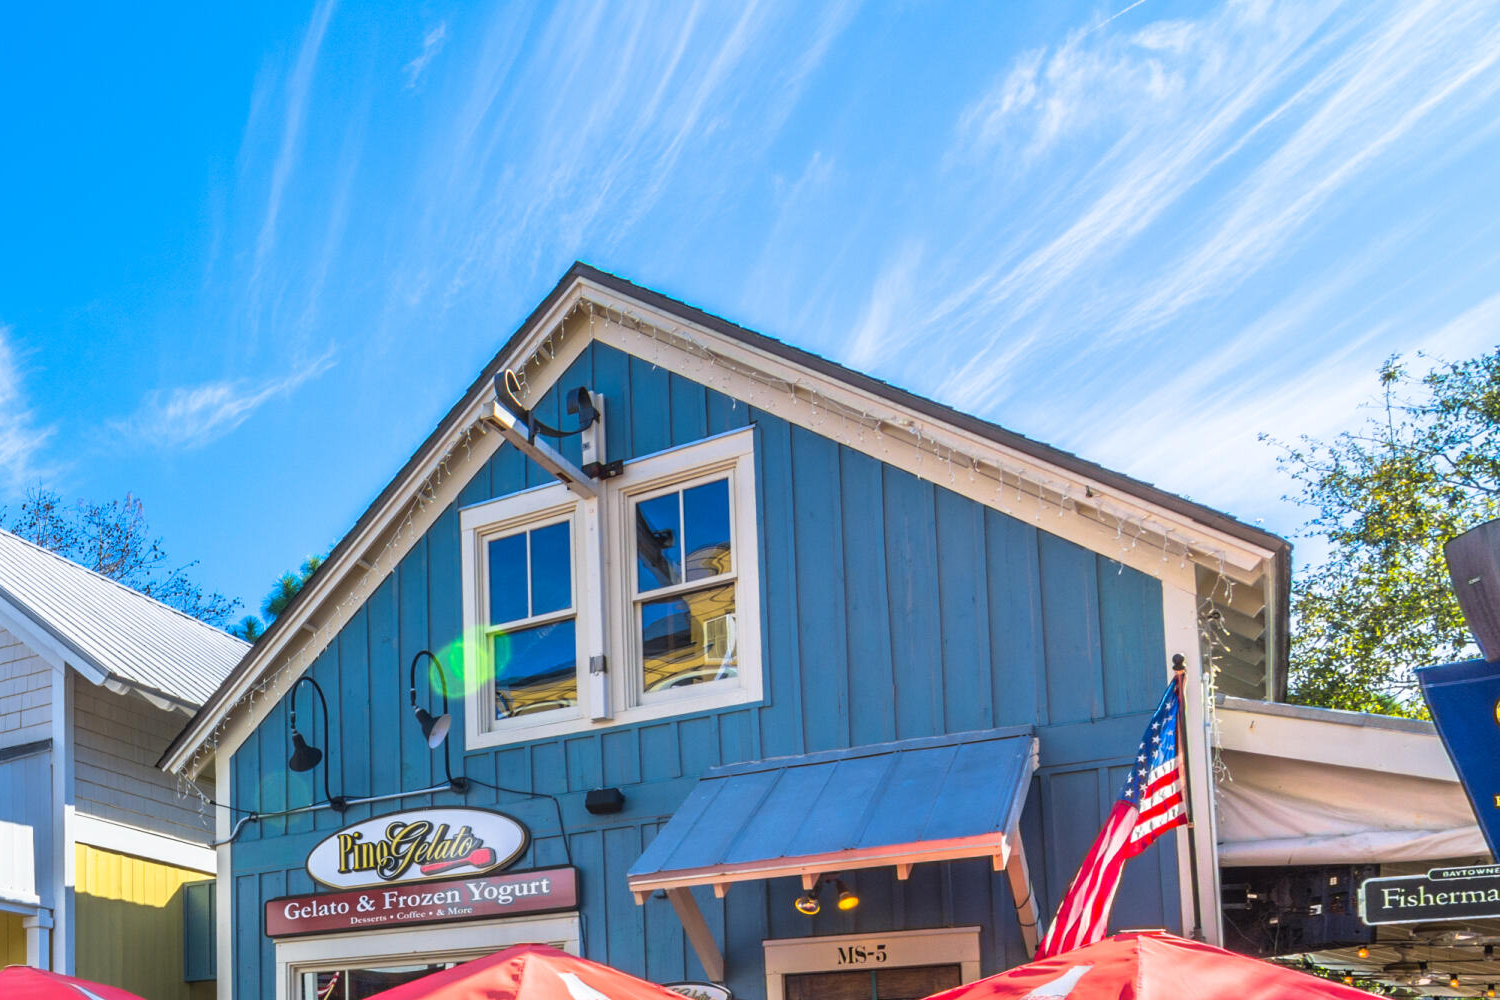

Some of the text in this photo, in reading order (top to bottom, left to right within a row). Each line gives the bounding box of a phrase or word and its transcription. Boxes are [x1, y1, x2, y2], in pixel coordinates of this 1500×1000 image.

[376, 820, 480, 880] Gelato
[1442, 867, 1500, 877] BAYTOWNE
[284, 878, 551, 920] Gelato & Frozen Yogurt
[1382, 886, 1500, 909] Fisherma
[350, 907, 473, 924] Desserts Coffee & More
[838, 944, 887, 965] MS-5
